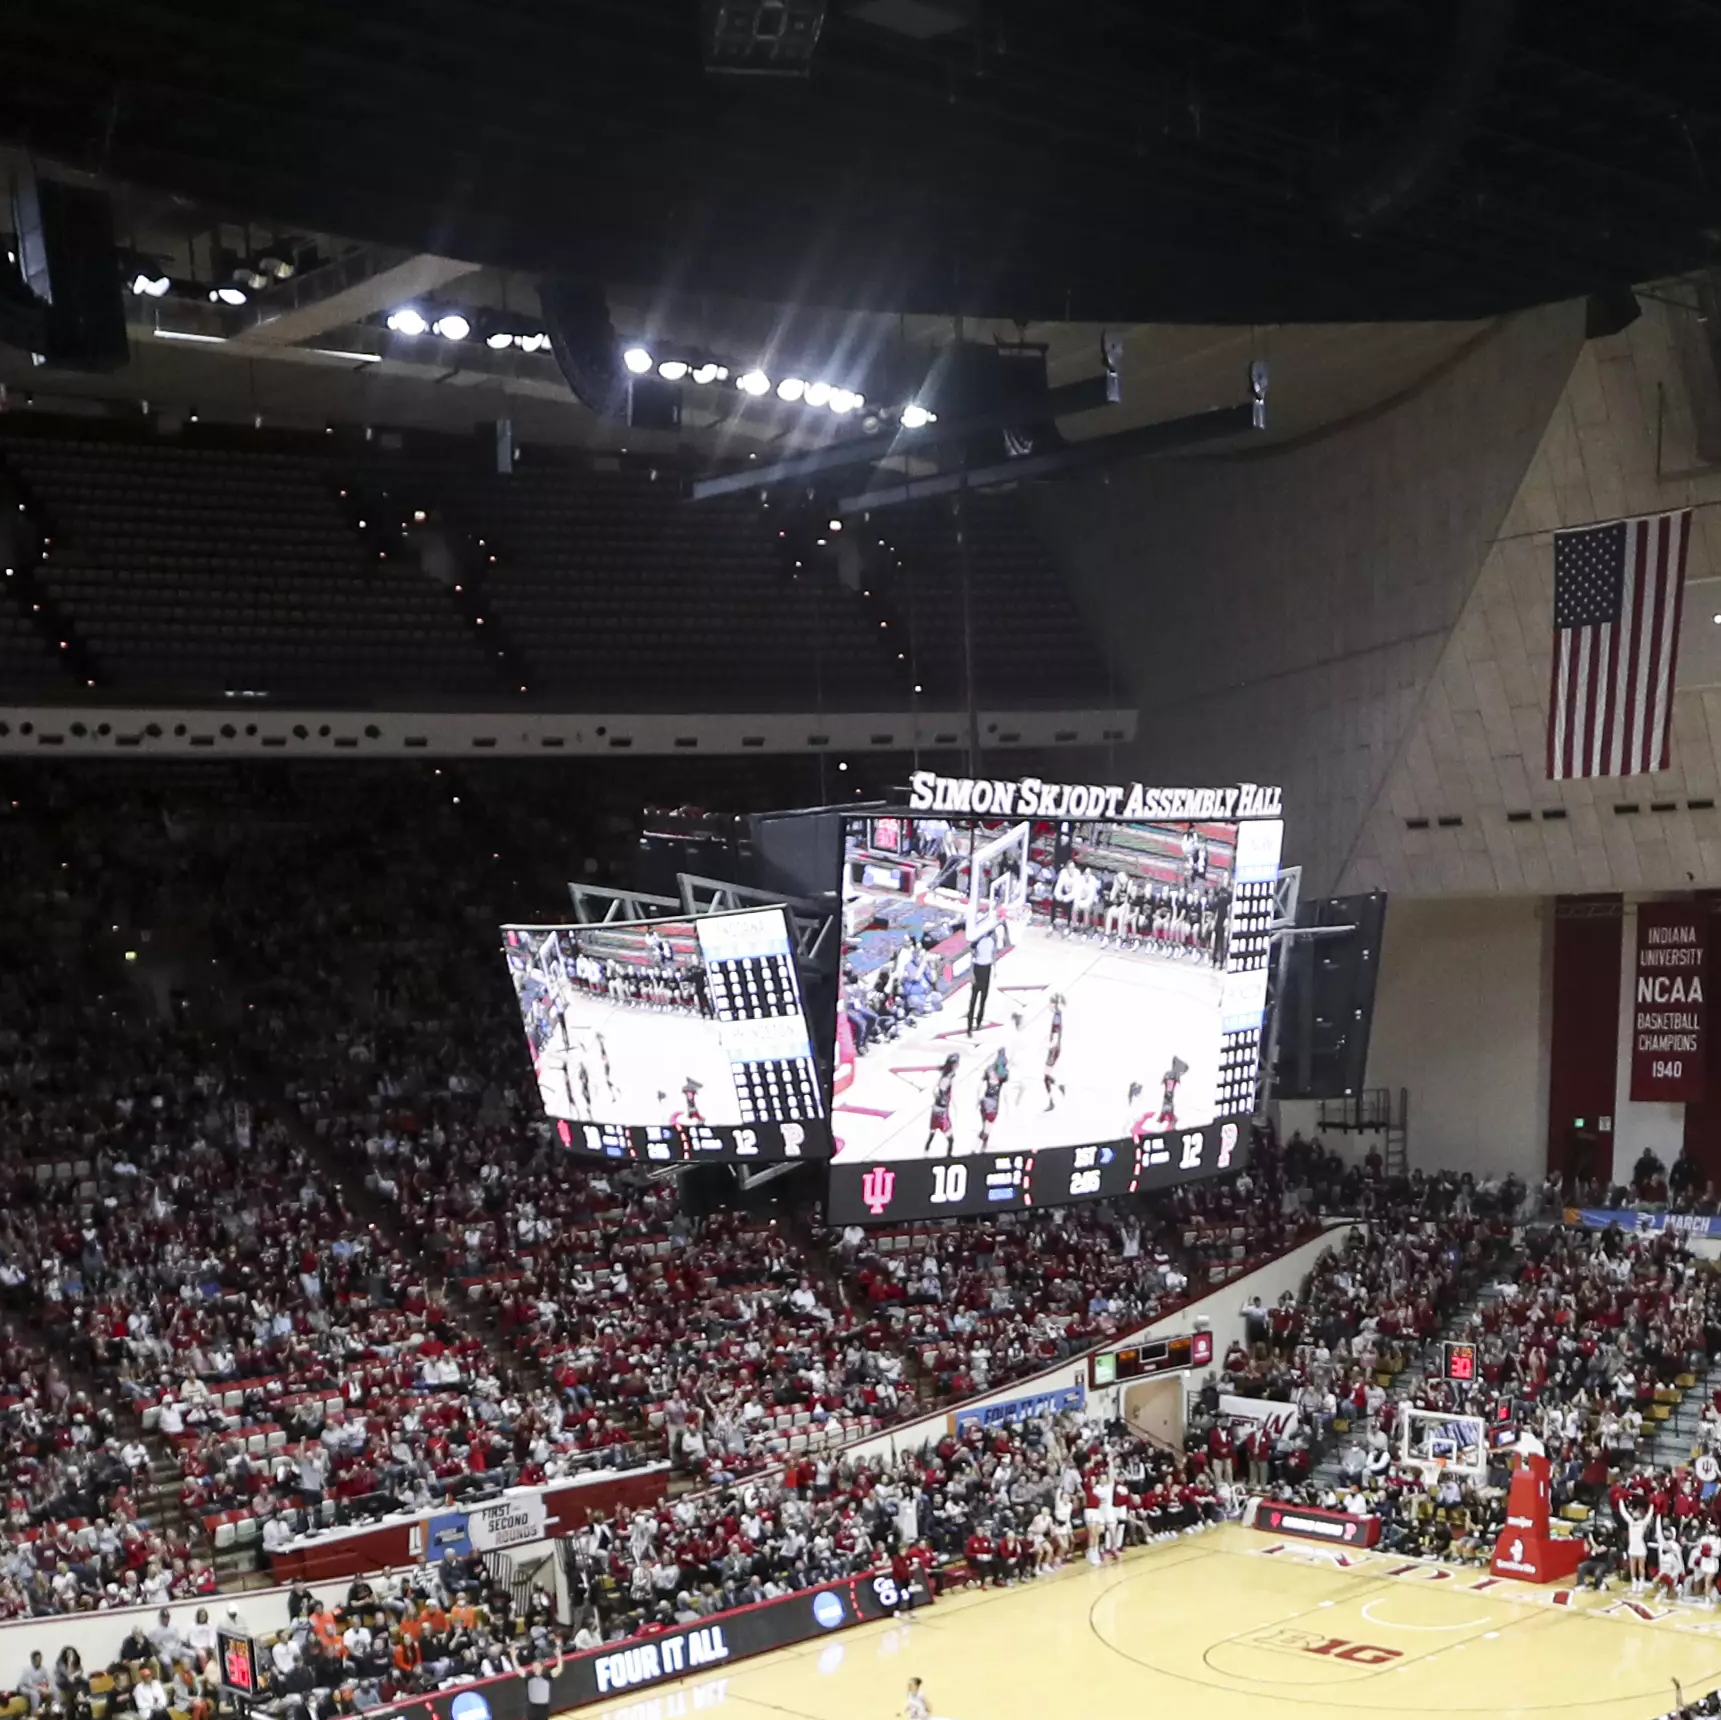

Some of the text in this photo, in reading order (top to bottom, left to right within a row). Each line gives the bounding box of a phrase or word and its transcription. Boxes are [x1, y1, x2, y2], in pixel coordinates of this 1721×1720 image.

[910, 770, 1282, 817] SIMON SKJODT ASSEMBLY HALL
[1648, 926, 1696, 944] INDIANA
[1640, 948, 1703, 967] UNIVERSITY
[1637, 976, 1703, 1003] NCAA
[1637, 1013, 1700, 1029] BASKETBALL
[1639, 1034, 1697, 1051] CHAMPIONS
[1652, 1061, 1682, 1078] 1940
[733, 1130, 758, 1155] 12
[1180, 1132, 1205, 1169] 12
[930, 1163, 969, 1204] 10
[1664, 1214, 1711, 1232] MARCH
[1451, 1356, 1473, 1378] 30
[482, 1503, 511, 1521] FIRST
[488, 1513, 528, 1533] SECOND
[495, 1524, 537, 1546] ROUNDS
[595, 1626, 728, 1692] FOUR IT ALL
